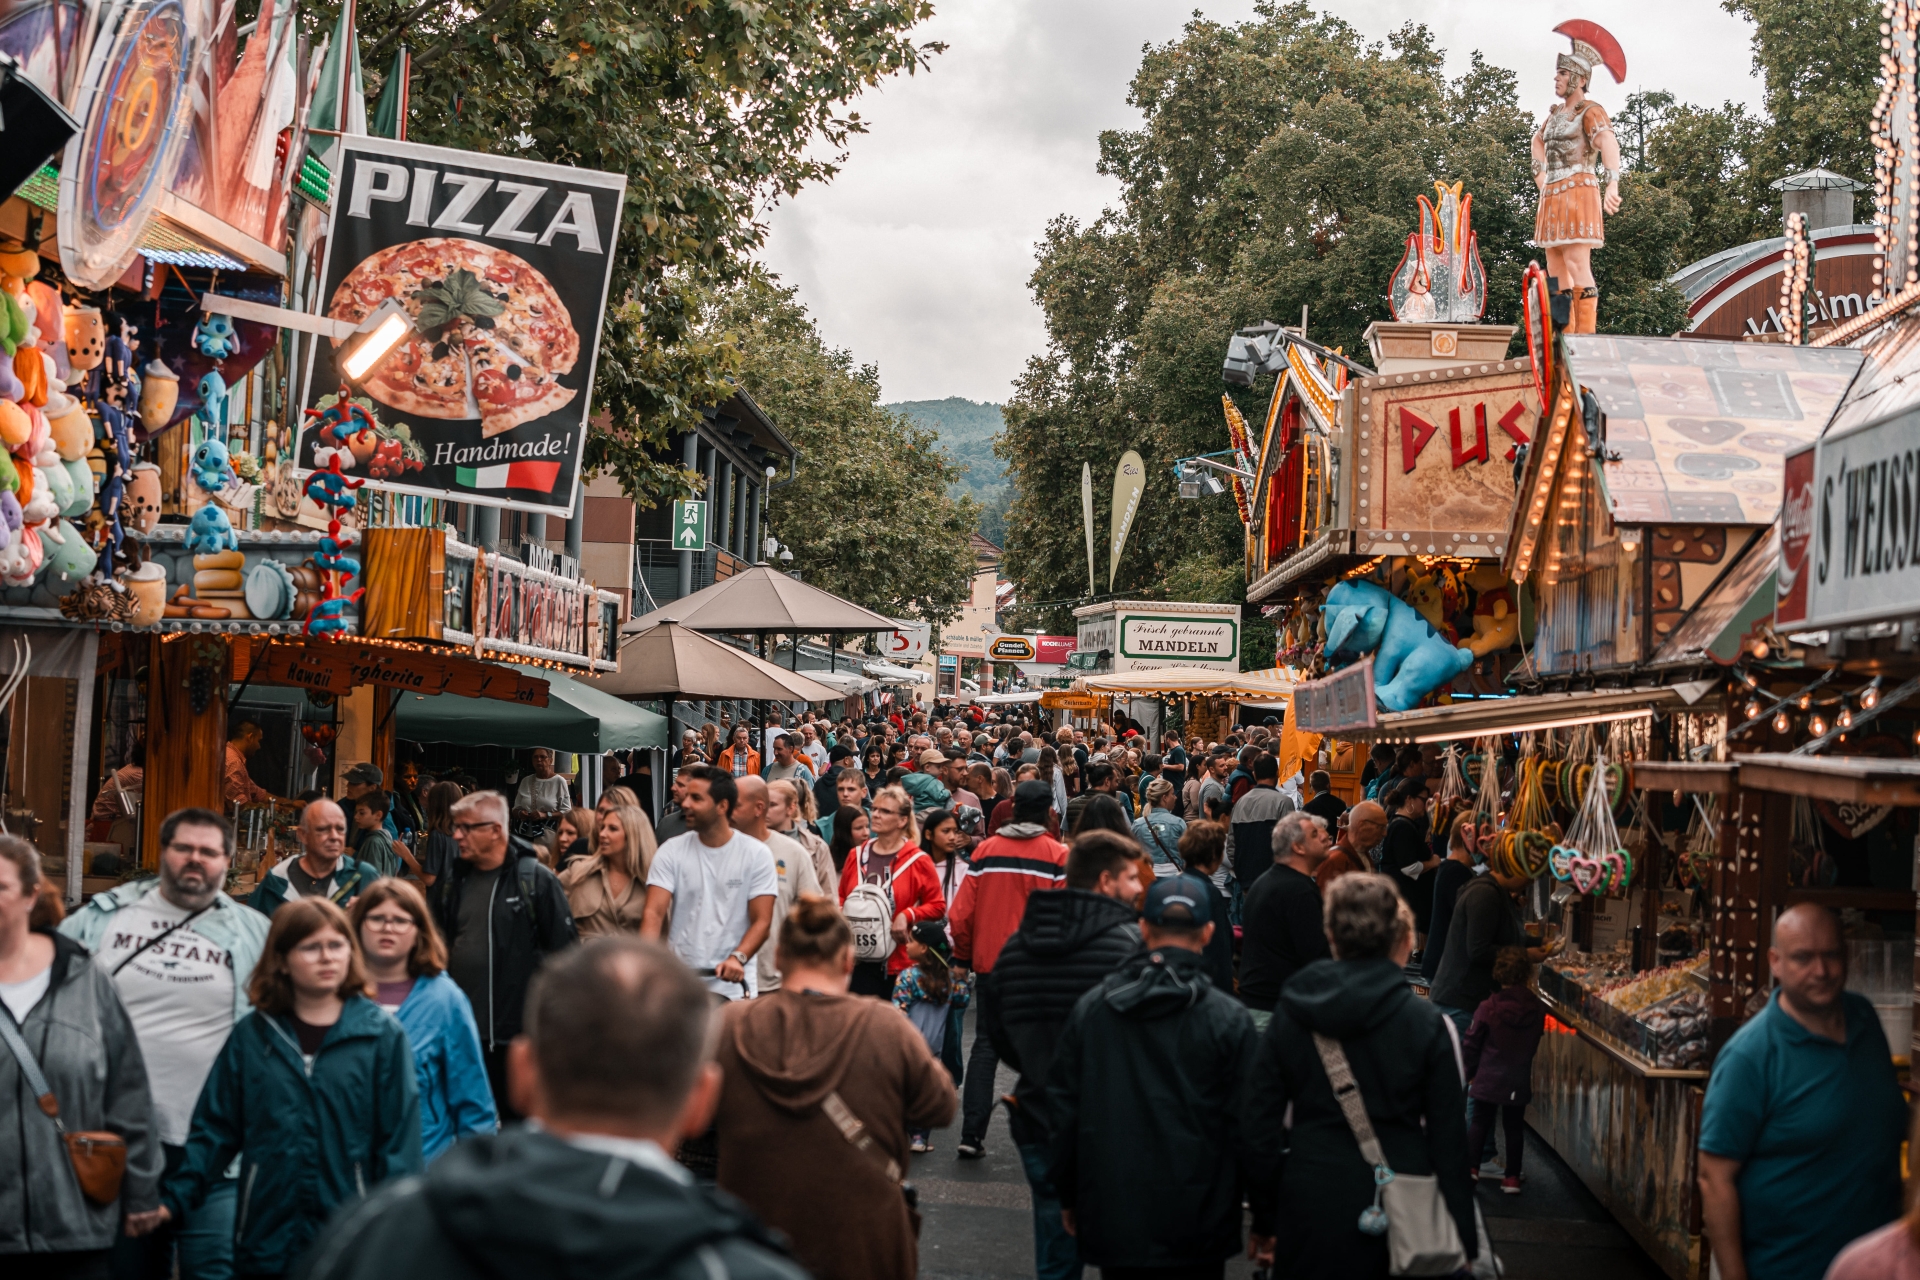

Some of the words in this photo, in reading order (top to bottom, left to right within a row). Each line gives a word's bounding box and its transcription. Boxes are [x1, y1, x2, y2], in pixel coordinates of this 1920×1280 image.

[347, 158, 604, 255] PIZZA
[432, 432, 571, 466] Handmade!
[1122, 463, 1139, 477] Ries
[1113, 486, 1140, 555] MANDELN
[1133, 622, 1167, 635] Frisch
[1171, 624, 1225, 639] gebrannte
[1138, 639, 1219, 654] MANDELN
[287, 661, 333, 687] Hawaii
[351, 663, 424, 688] rgherita
[856, 934, 877, 946] ESS
